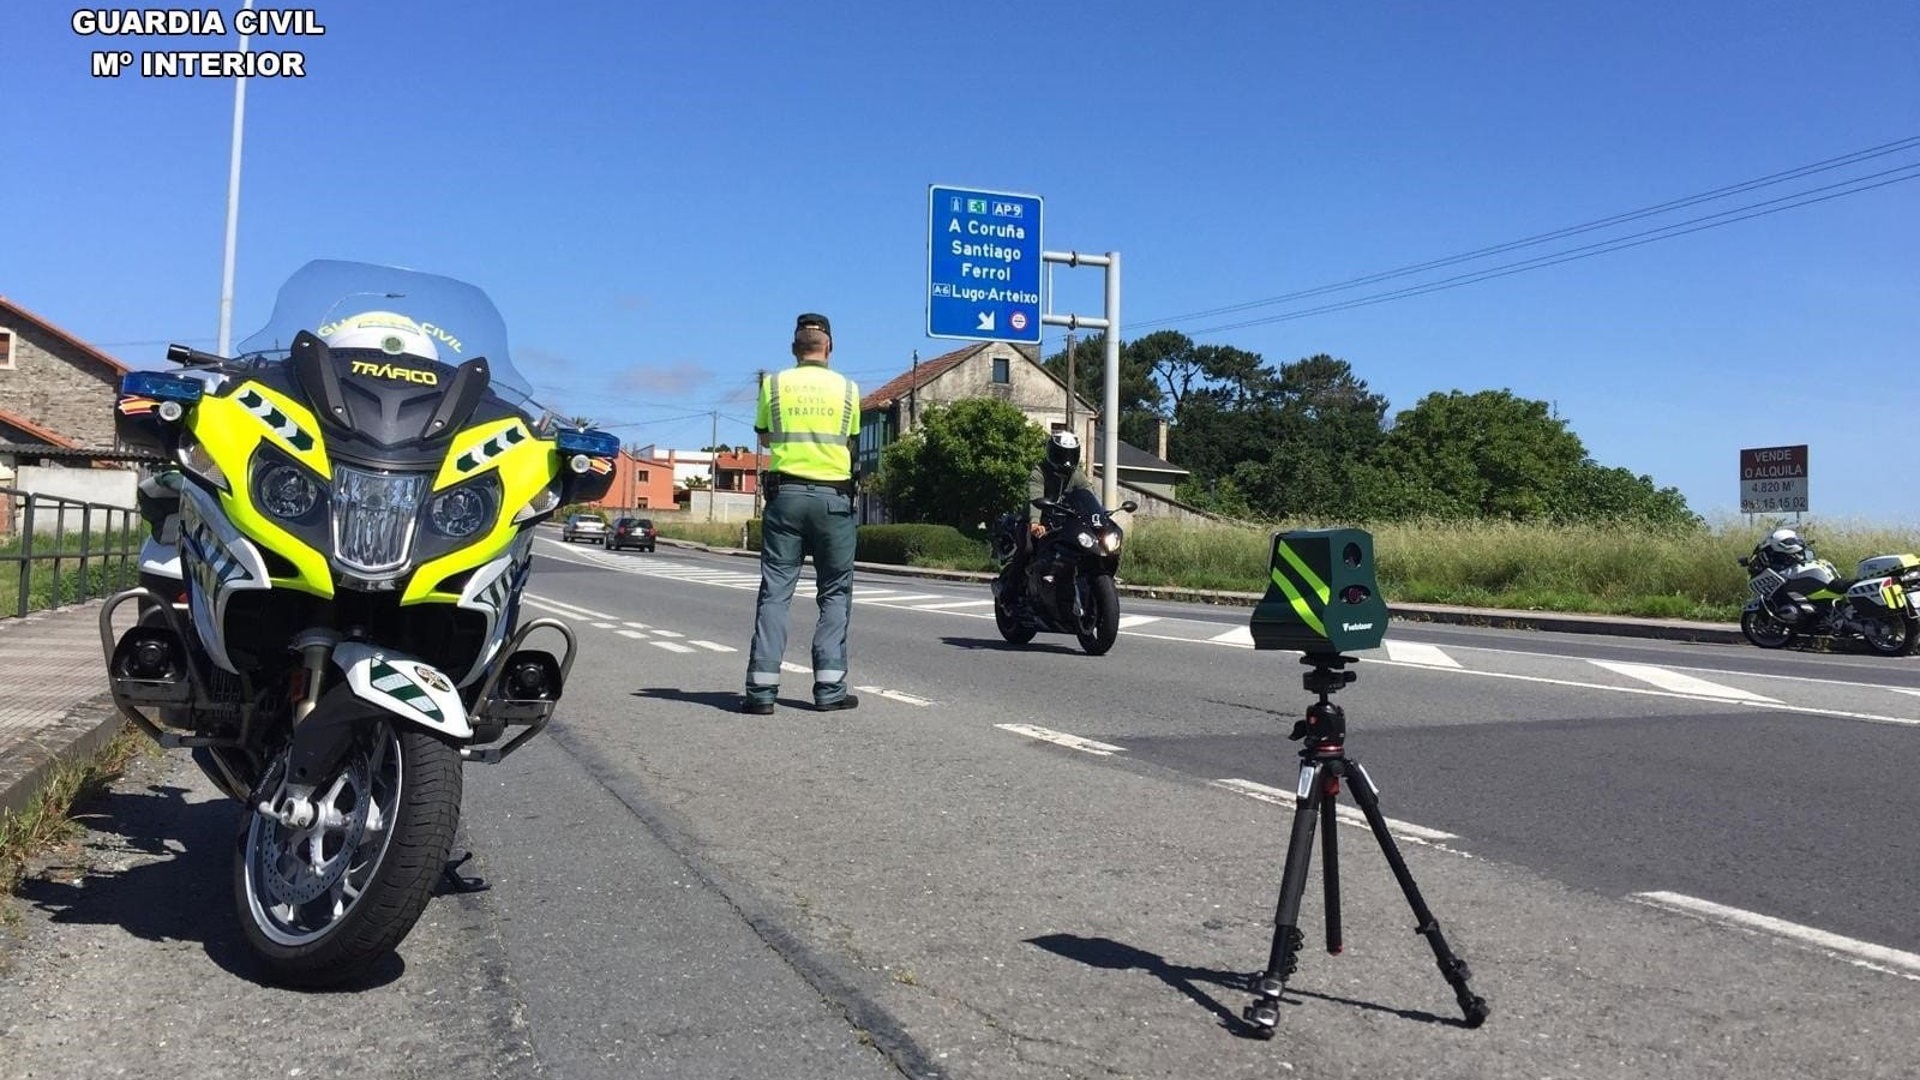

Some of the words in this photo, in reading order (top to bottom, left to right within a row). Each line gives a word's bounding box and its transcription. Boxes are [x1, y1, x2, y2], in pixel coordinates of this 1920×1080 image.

[949, 218, 961, 233] A
[968, 220, 1025, 239] Coruña
[952, 240, 1021, 262] Santiago
[962, 263, 1010, 281] Ferrol
[418, 322, 463, 353] CIVIL
[351, 360, 438, 386] TRÁFICO
[797, 395, 826, 404] CIVIL
[1754, 449, 1792, 462] VENDE
[1744, 468, 1753, 479] O
[1755, 464, 1803, 478] ALQUILA
